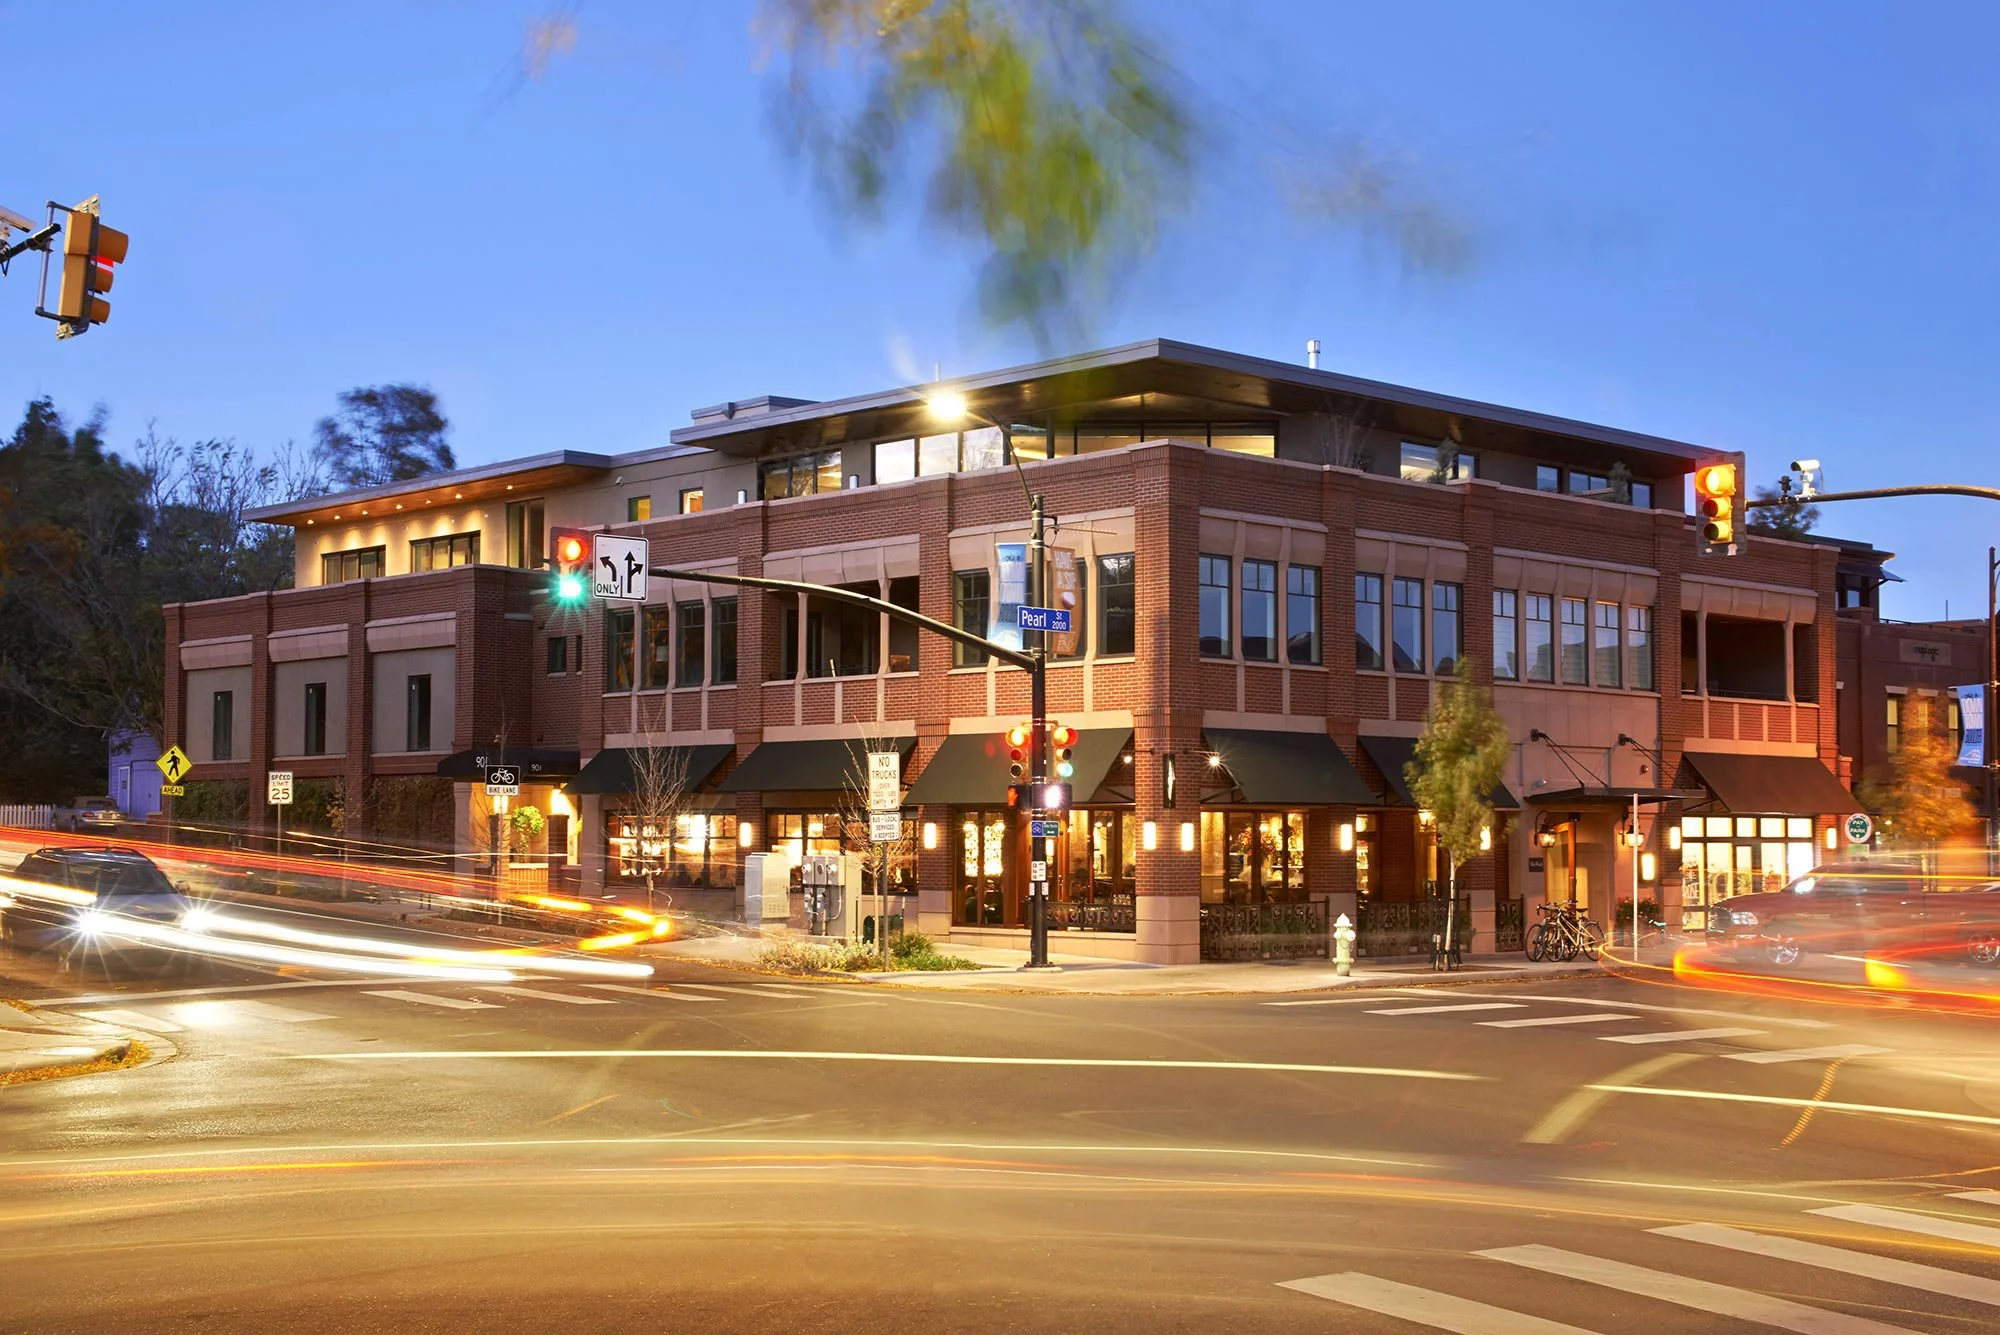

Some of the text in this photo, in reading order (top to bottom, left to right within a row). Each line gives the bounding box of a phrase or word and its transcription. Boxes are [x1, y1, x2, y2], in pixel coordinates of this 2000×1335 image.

[597, 583, 619, 594] ONLY
[1021, 610, 1063, 627] Pearl St
[1052, 620, 1067, 630] 2000
[476, 756, 488, 768] 901
[531, 763, 542, 771] 901
[878, 756, 890, 767] NO
[872, 770, 897, 780] TRUCKS
[163, 786, 183, 794] AHEAD
[271, 788, 290, 800] 25
